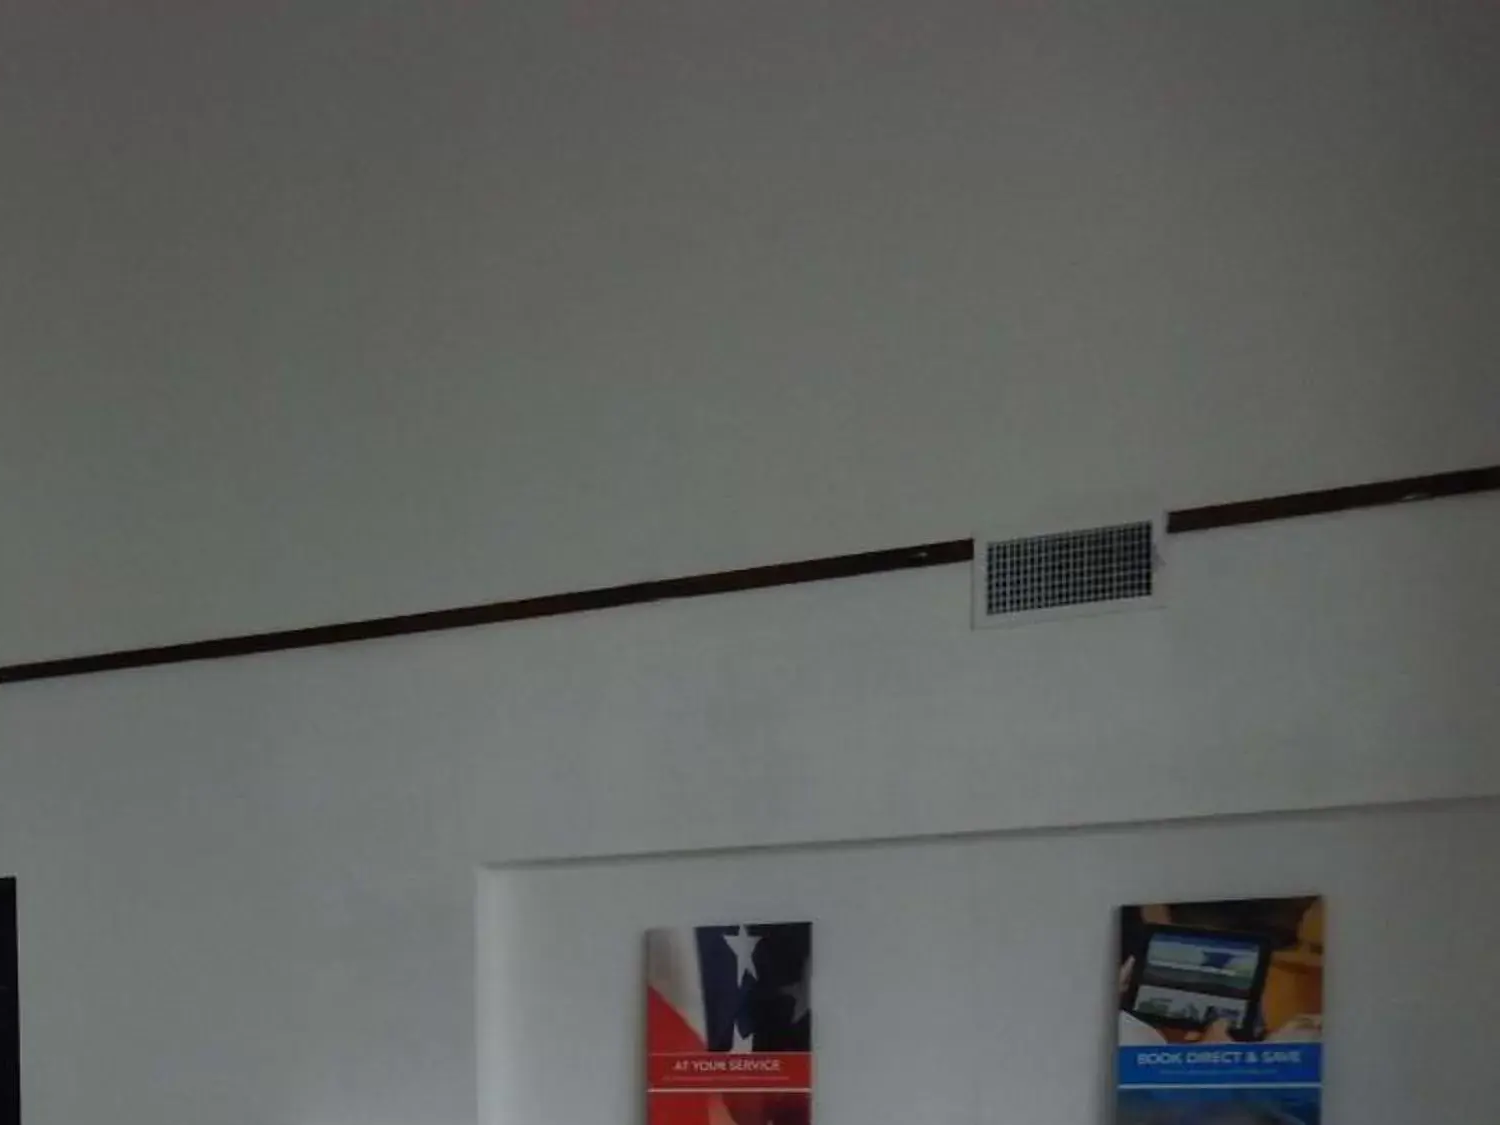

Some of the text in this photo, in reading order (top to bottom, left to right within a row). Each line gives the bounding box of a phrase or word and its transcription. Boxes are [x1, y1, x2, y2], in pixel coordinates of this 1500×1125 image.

[1137, 1052, 1182, 1065] BOOK
[1186, 1052, 1242, 1064] DIRECT
[1262, 1051, 1301, 1064] SAVE
[673, 1059, 781, 1071] AT YOUR SERVICE
